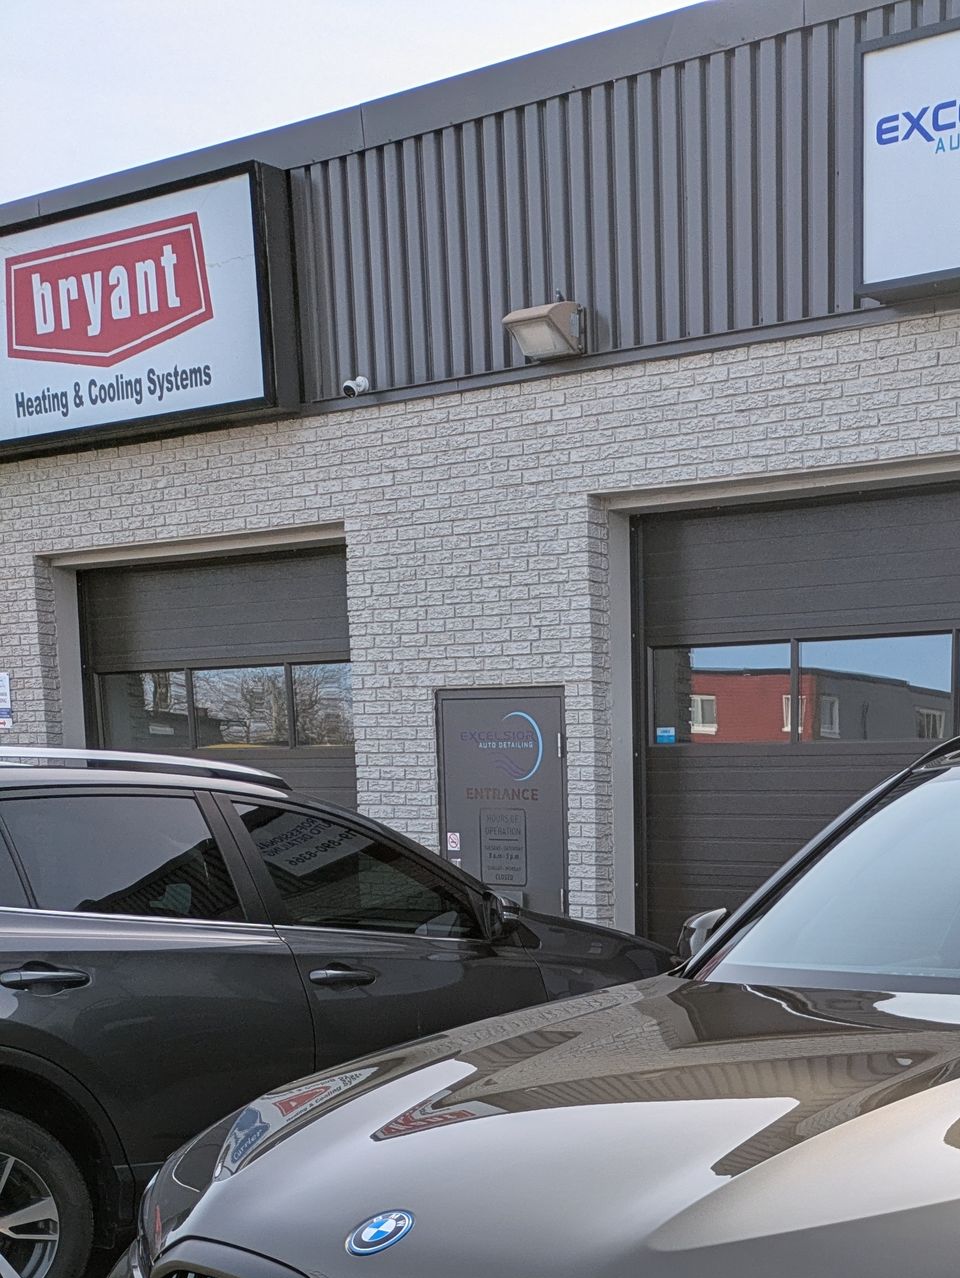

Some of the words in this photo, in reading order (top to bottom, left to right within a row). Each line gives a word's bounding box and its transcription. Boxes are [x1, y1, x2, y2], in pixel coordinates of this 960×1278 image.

[31, 244, 181, 337] bryant
[15, 387, 69, 418] Heating
[73, 381, 84, 408] &
[88, 374, 143, 404] Cooling
[147, 364, 212, 401] Systems
[460, 731, 537, 743] EXCELSIOR
[479, 741, 496, 749] AUTO
[466, 787, 540, 800] ENTRANCE
